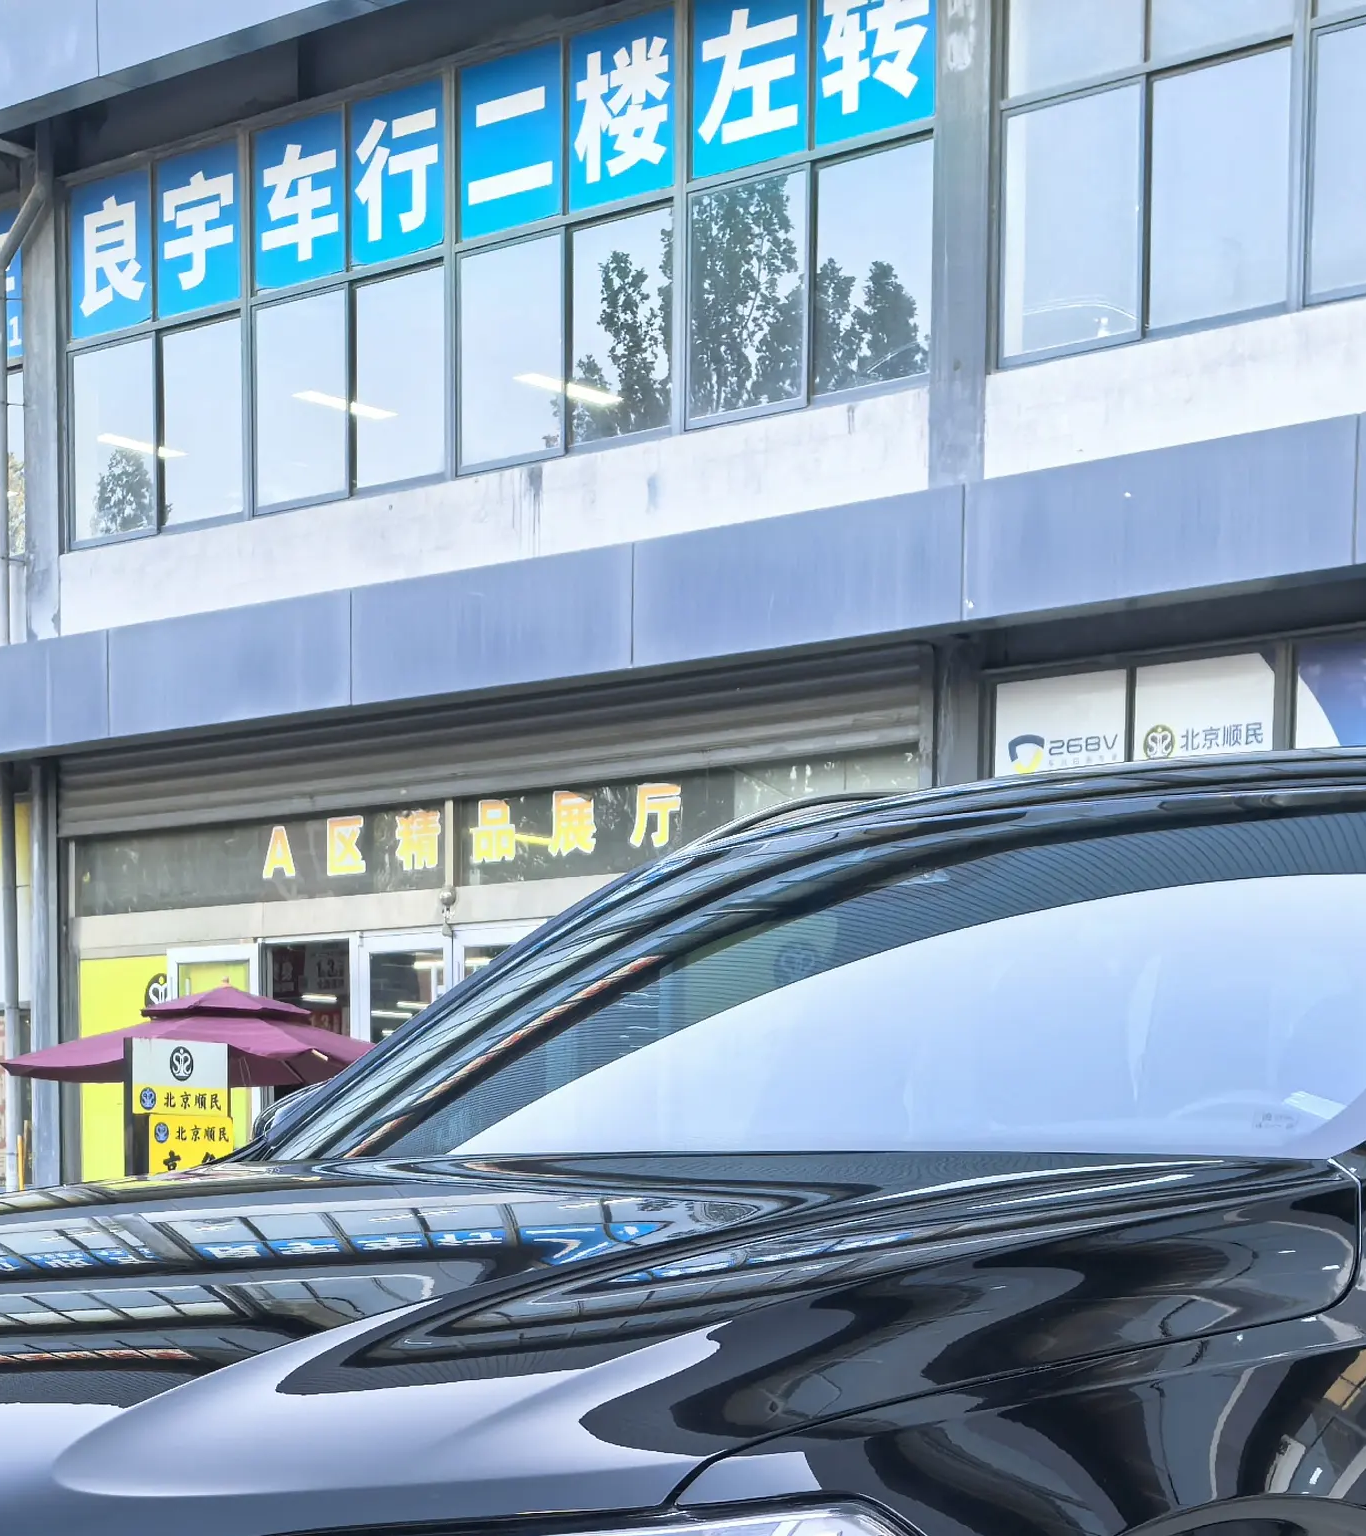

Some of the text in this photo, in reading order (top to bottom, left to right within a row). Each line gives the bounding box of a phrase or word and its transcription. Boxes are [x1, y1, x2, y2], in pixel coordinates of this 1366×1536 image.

[80, 0, 929, 316] 良宇车行二楼左转
[1180, 722, 1264, 750] 北京顺民
[262, 782, 682, 879] A区精品展厅
